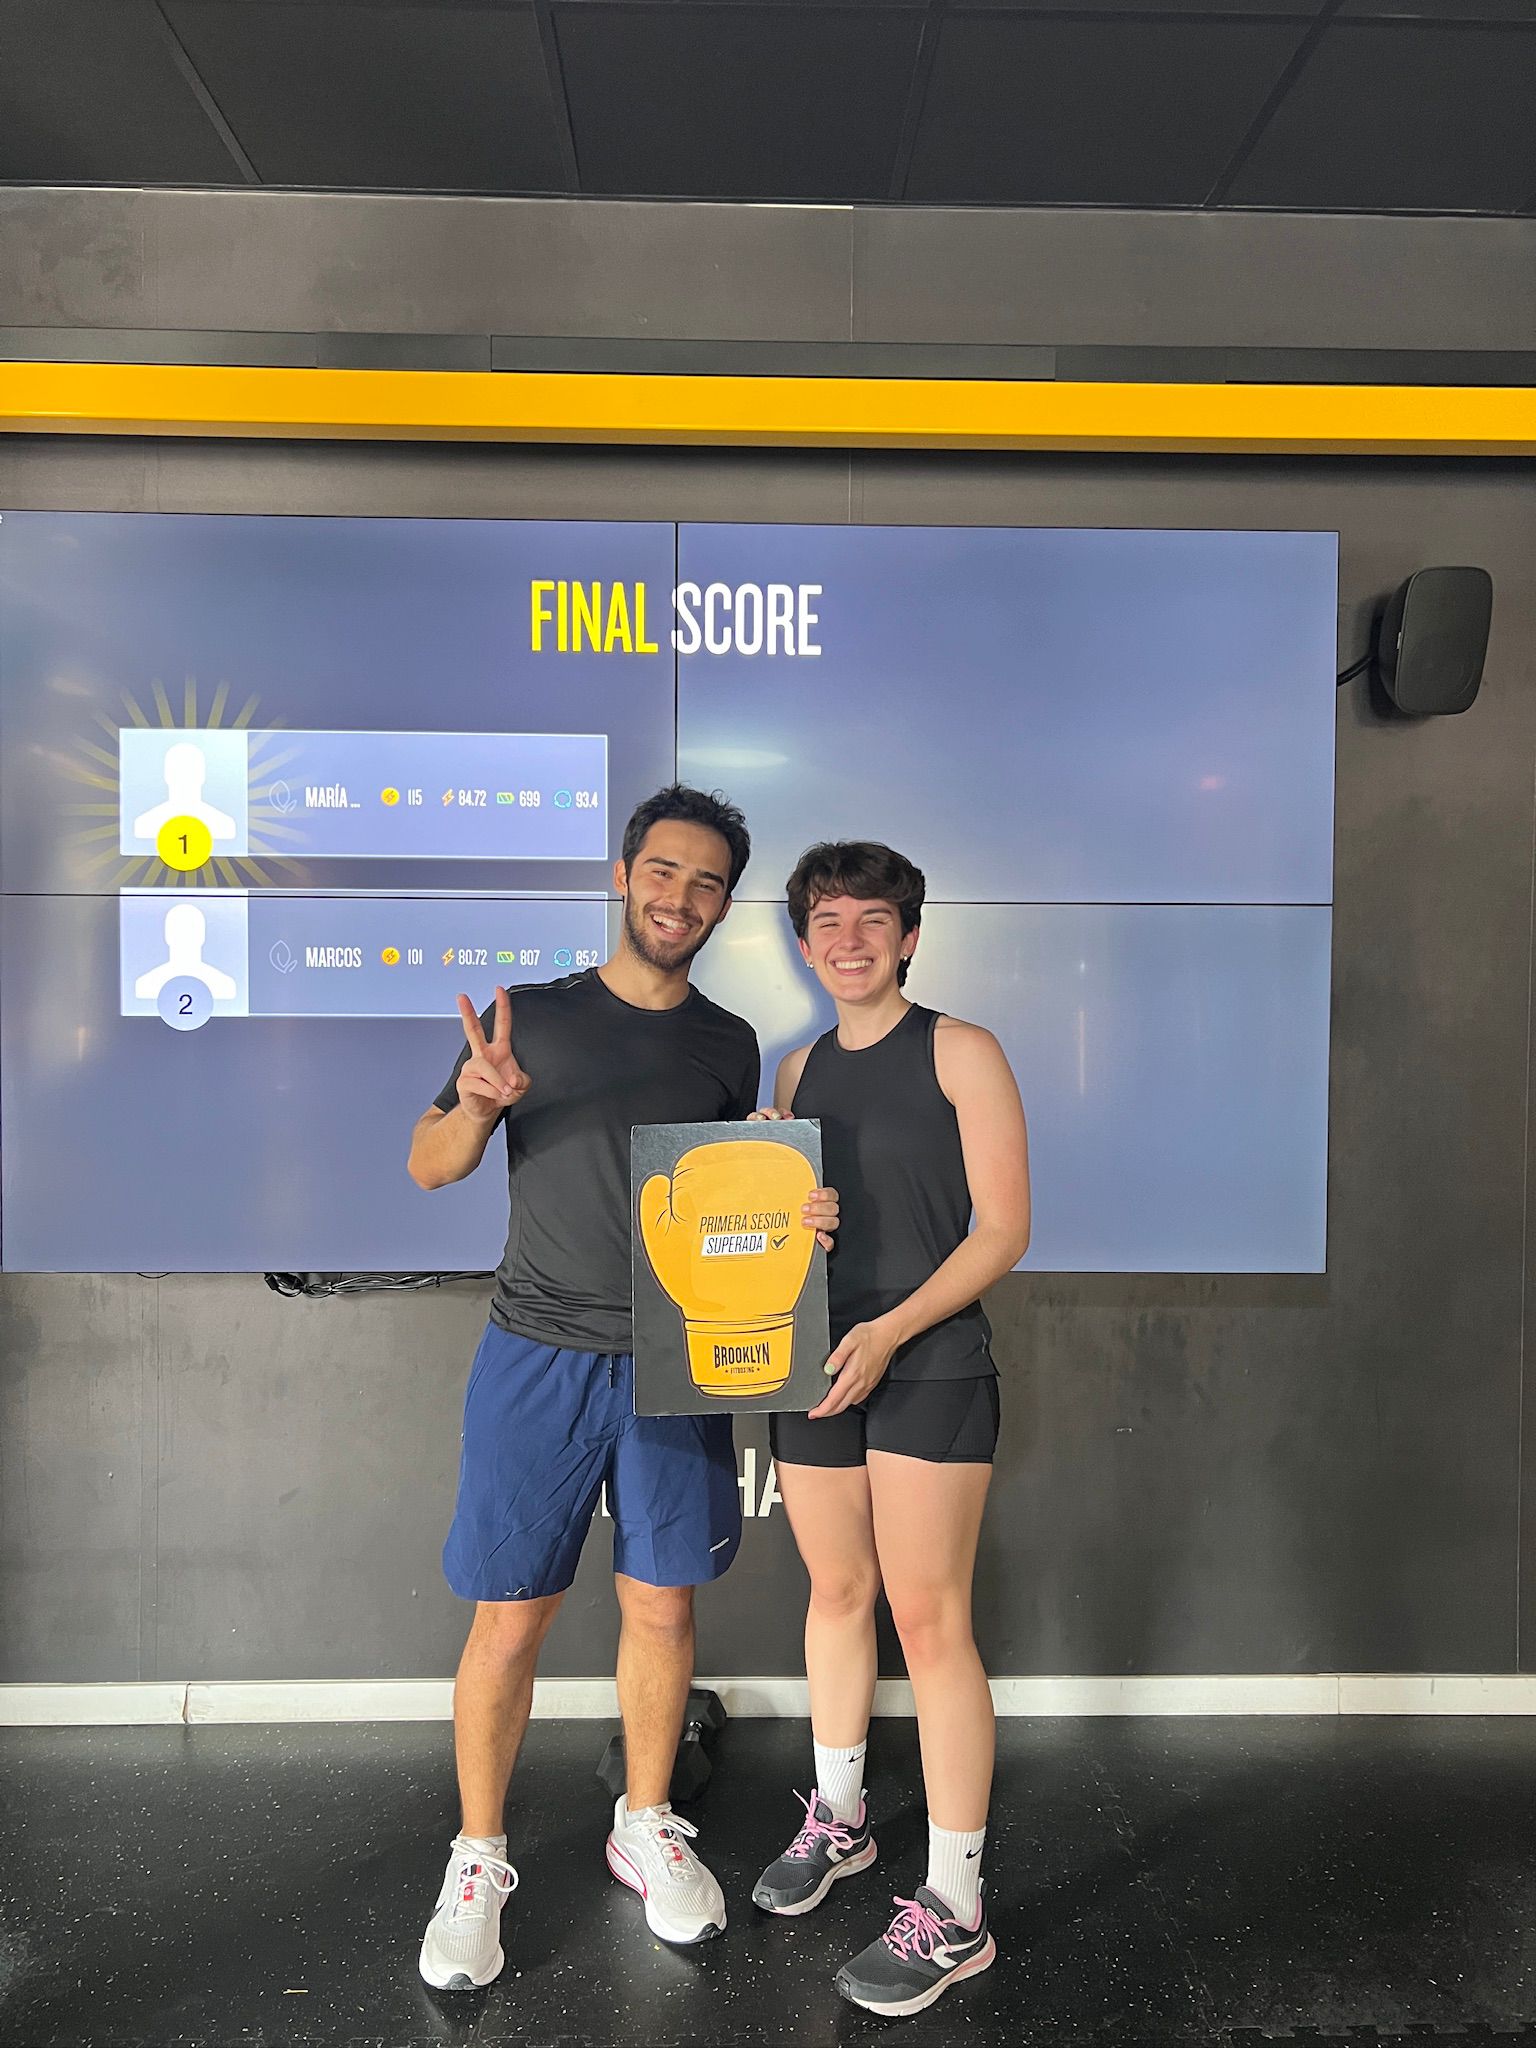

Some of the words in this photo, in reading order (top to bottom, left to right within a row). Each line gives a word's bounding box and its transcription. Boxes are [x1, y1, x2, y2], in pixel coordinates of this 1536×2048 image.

[531, 580, 659, 653] FINAL
[670, 582, 823, 656] SCORE
[305, 783, 348, 808] MARÍA
[407, 788, 423, 806] 115
[458, 789, 487, 807] 84.72
[519, 790, 541, 808] 699
[575, 791, 599, 809] 93.4
[178, 834, 188, 855] 1
[305, 946, 362, 968] MARCOS
[407, 948, 423, 965] 101
[458, 949, 488, 966] 80.72
[519, 949, 541, 966] 807
[575, 950, 599, 967] 85.2
[178, 994, 193, 1015] 2
[699, 1214, 748, 1234] PRIMERA
[750, 1208, 791, 1230] SESIÓN
[706, 1235, 764, 1255] SUPERADA
[713, 1341, 770, 1369] BROOKLYN
